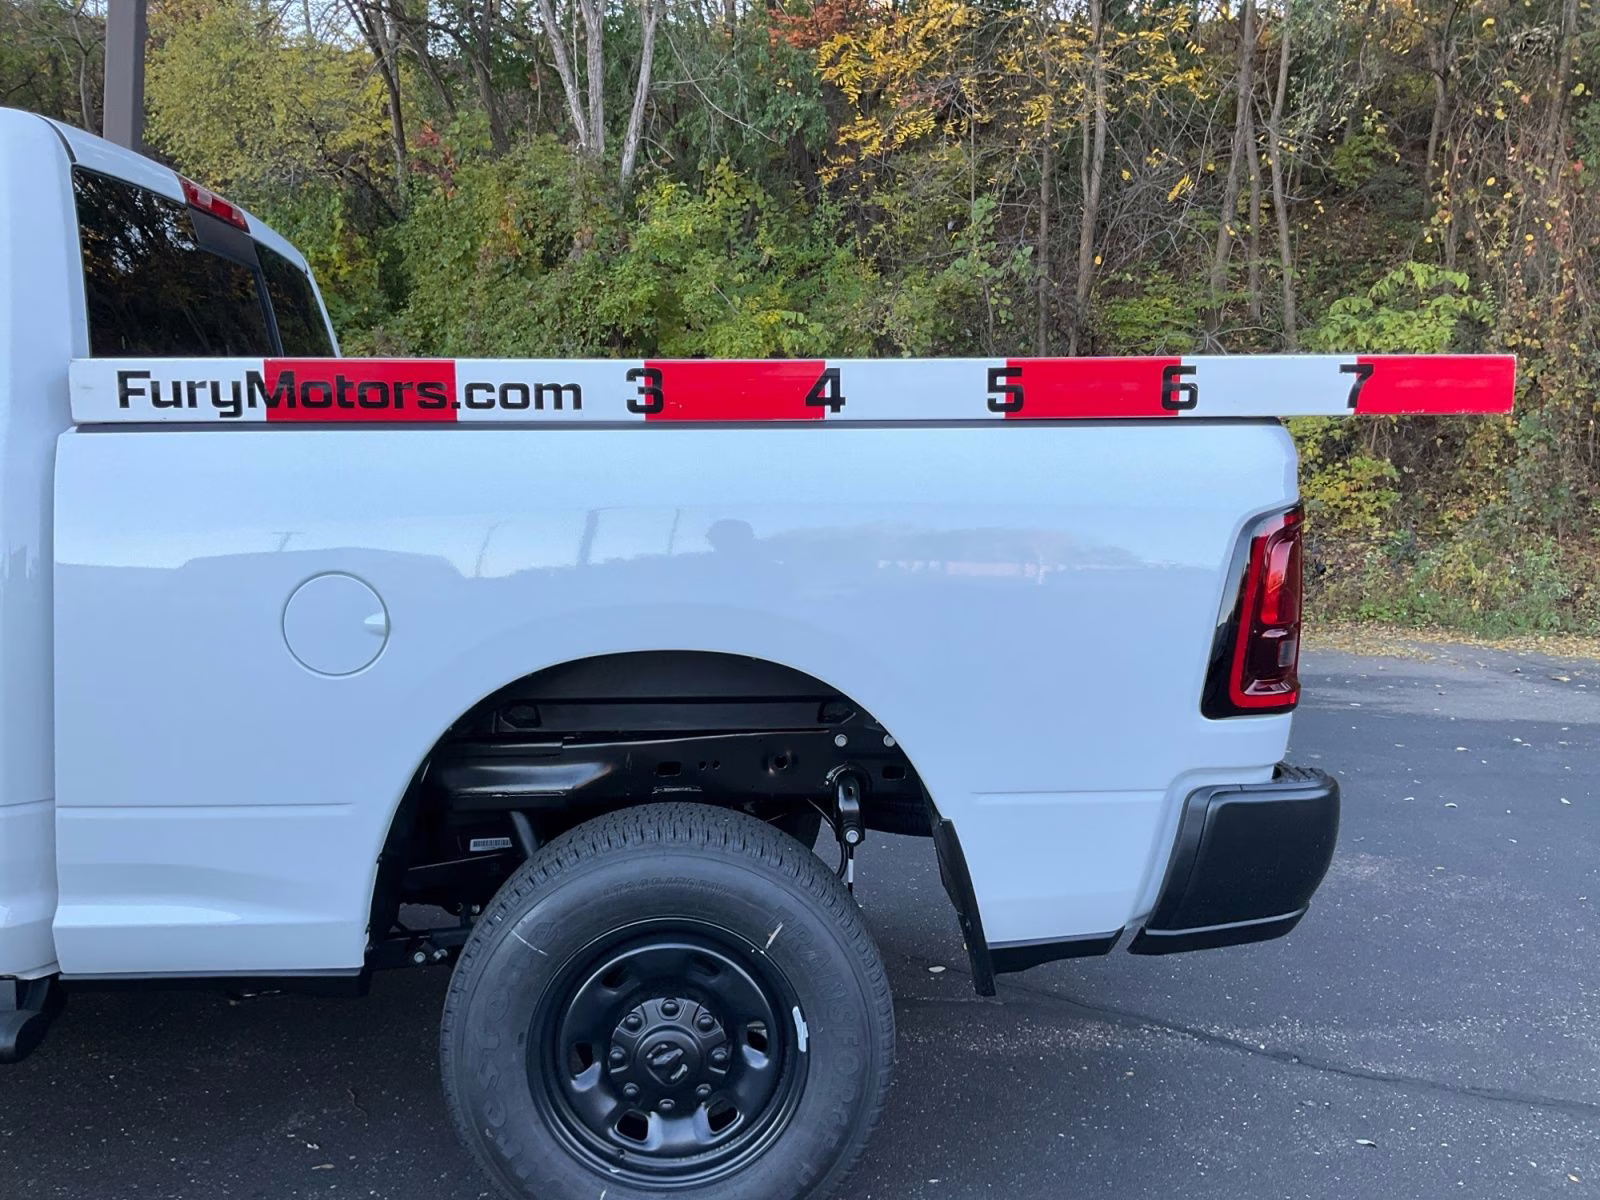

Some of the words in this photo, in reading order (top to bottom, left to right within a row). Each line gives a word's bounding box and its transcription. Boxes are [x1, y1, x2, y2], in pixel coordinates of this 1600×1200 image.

[116, 370, 583, 417] FuryMotors.com
[626, 367, 664, 414] 3
[805, 367, 846, 413] 4
[987, 367, 1024, 413] 5
[1161, 365, 1198, 411] 6
[1339, 363, 1375, 409] 7
